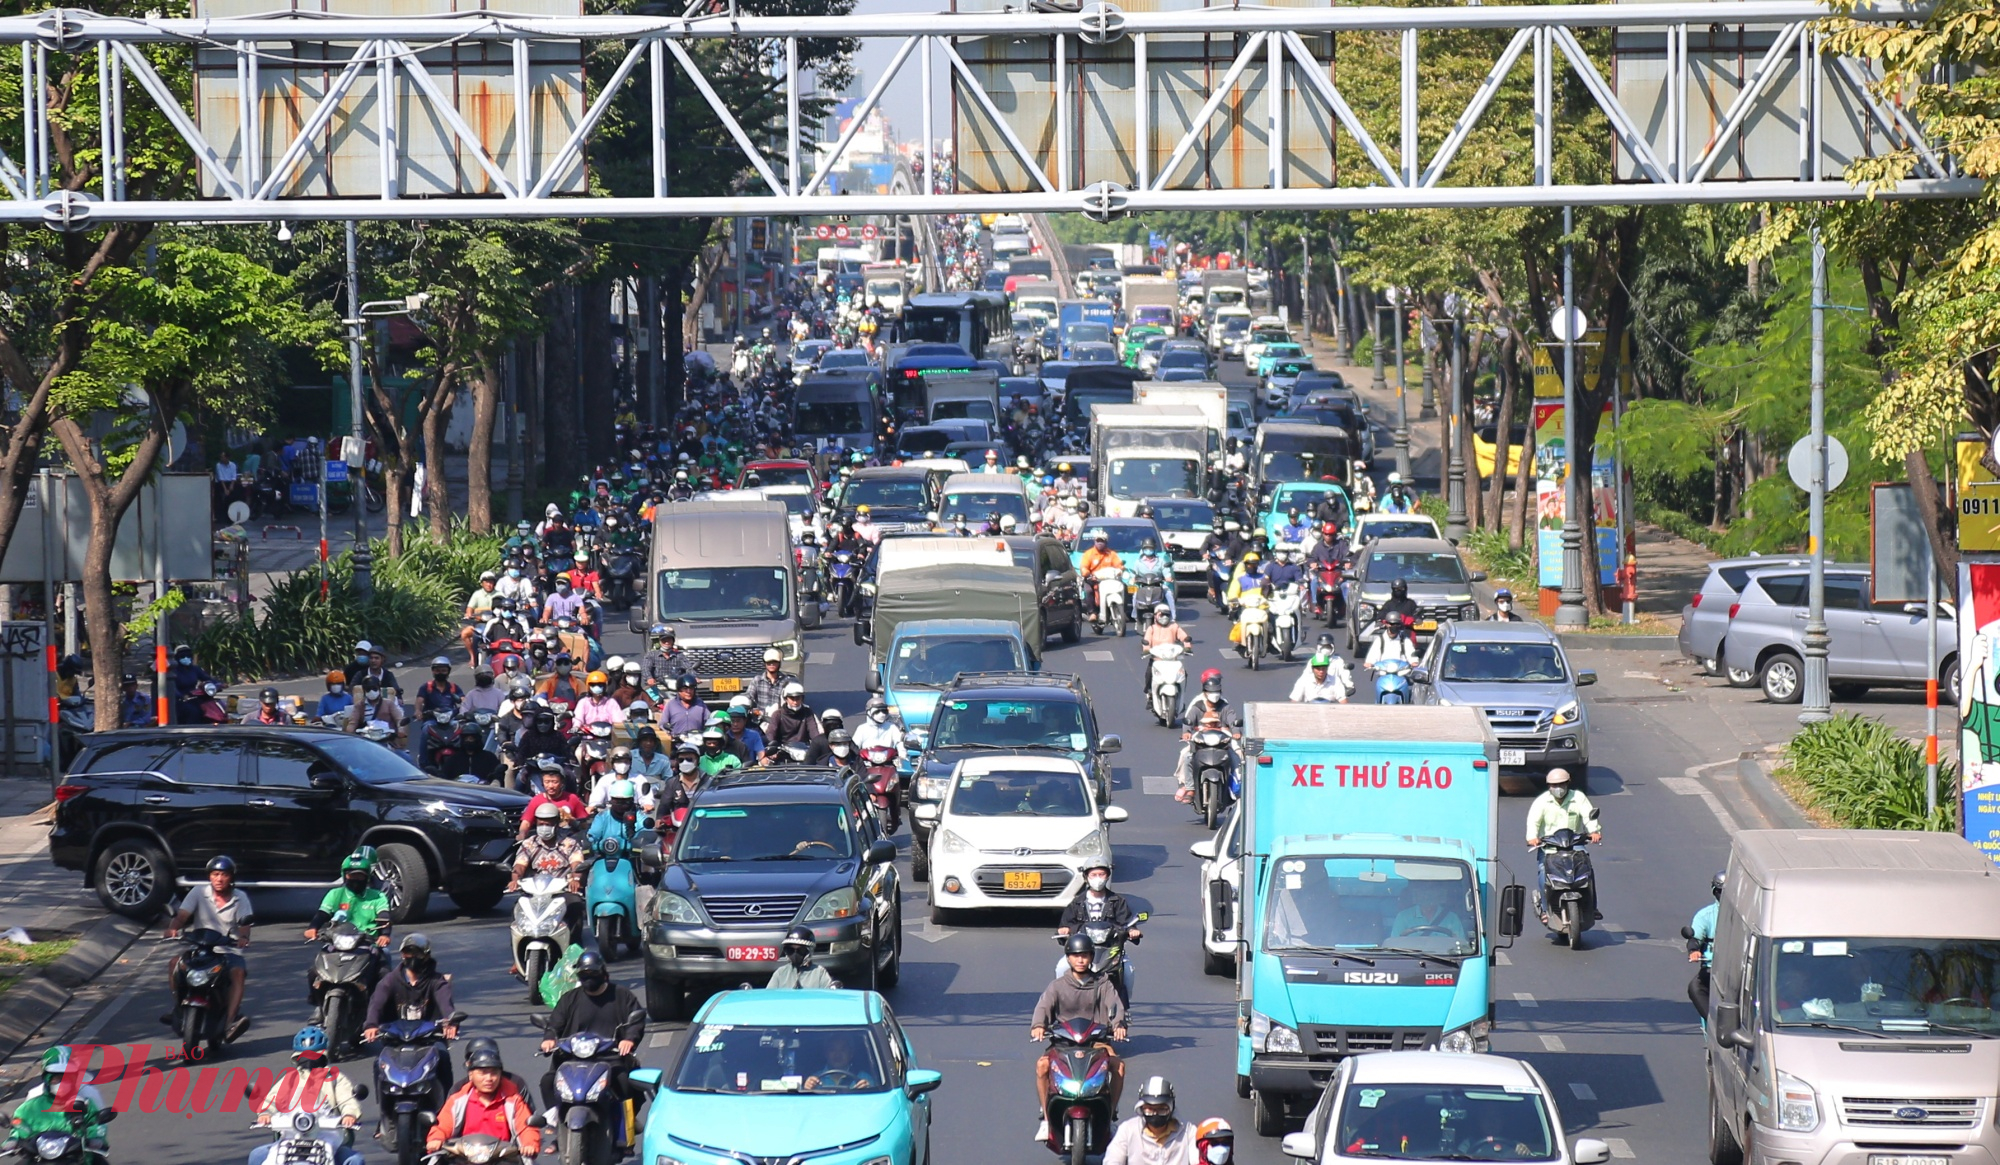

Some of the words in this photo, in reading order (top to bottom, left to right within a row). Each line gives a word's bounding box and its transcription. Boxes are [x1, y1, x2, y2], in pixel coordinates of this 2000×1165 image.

[1291, 764, 1325, 787] XE
[1335, 761, 1391, 788] THƯ
[1398, 760, 1453, 789] BÁO
[1015, 872, 1030, 880] 51F
[1008, 881, 1037, 889] 693.47
[1344, 972, 1399, 984] ISUZU
